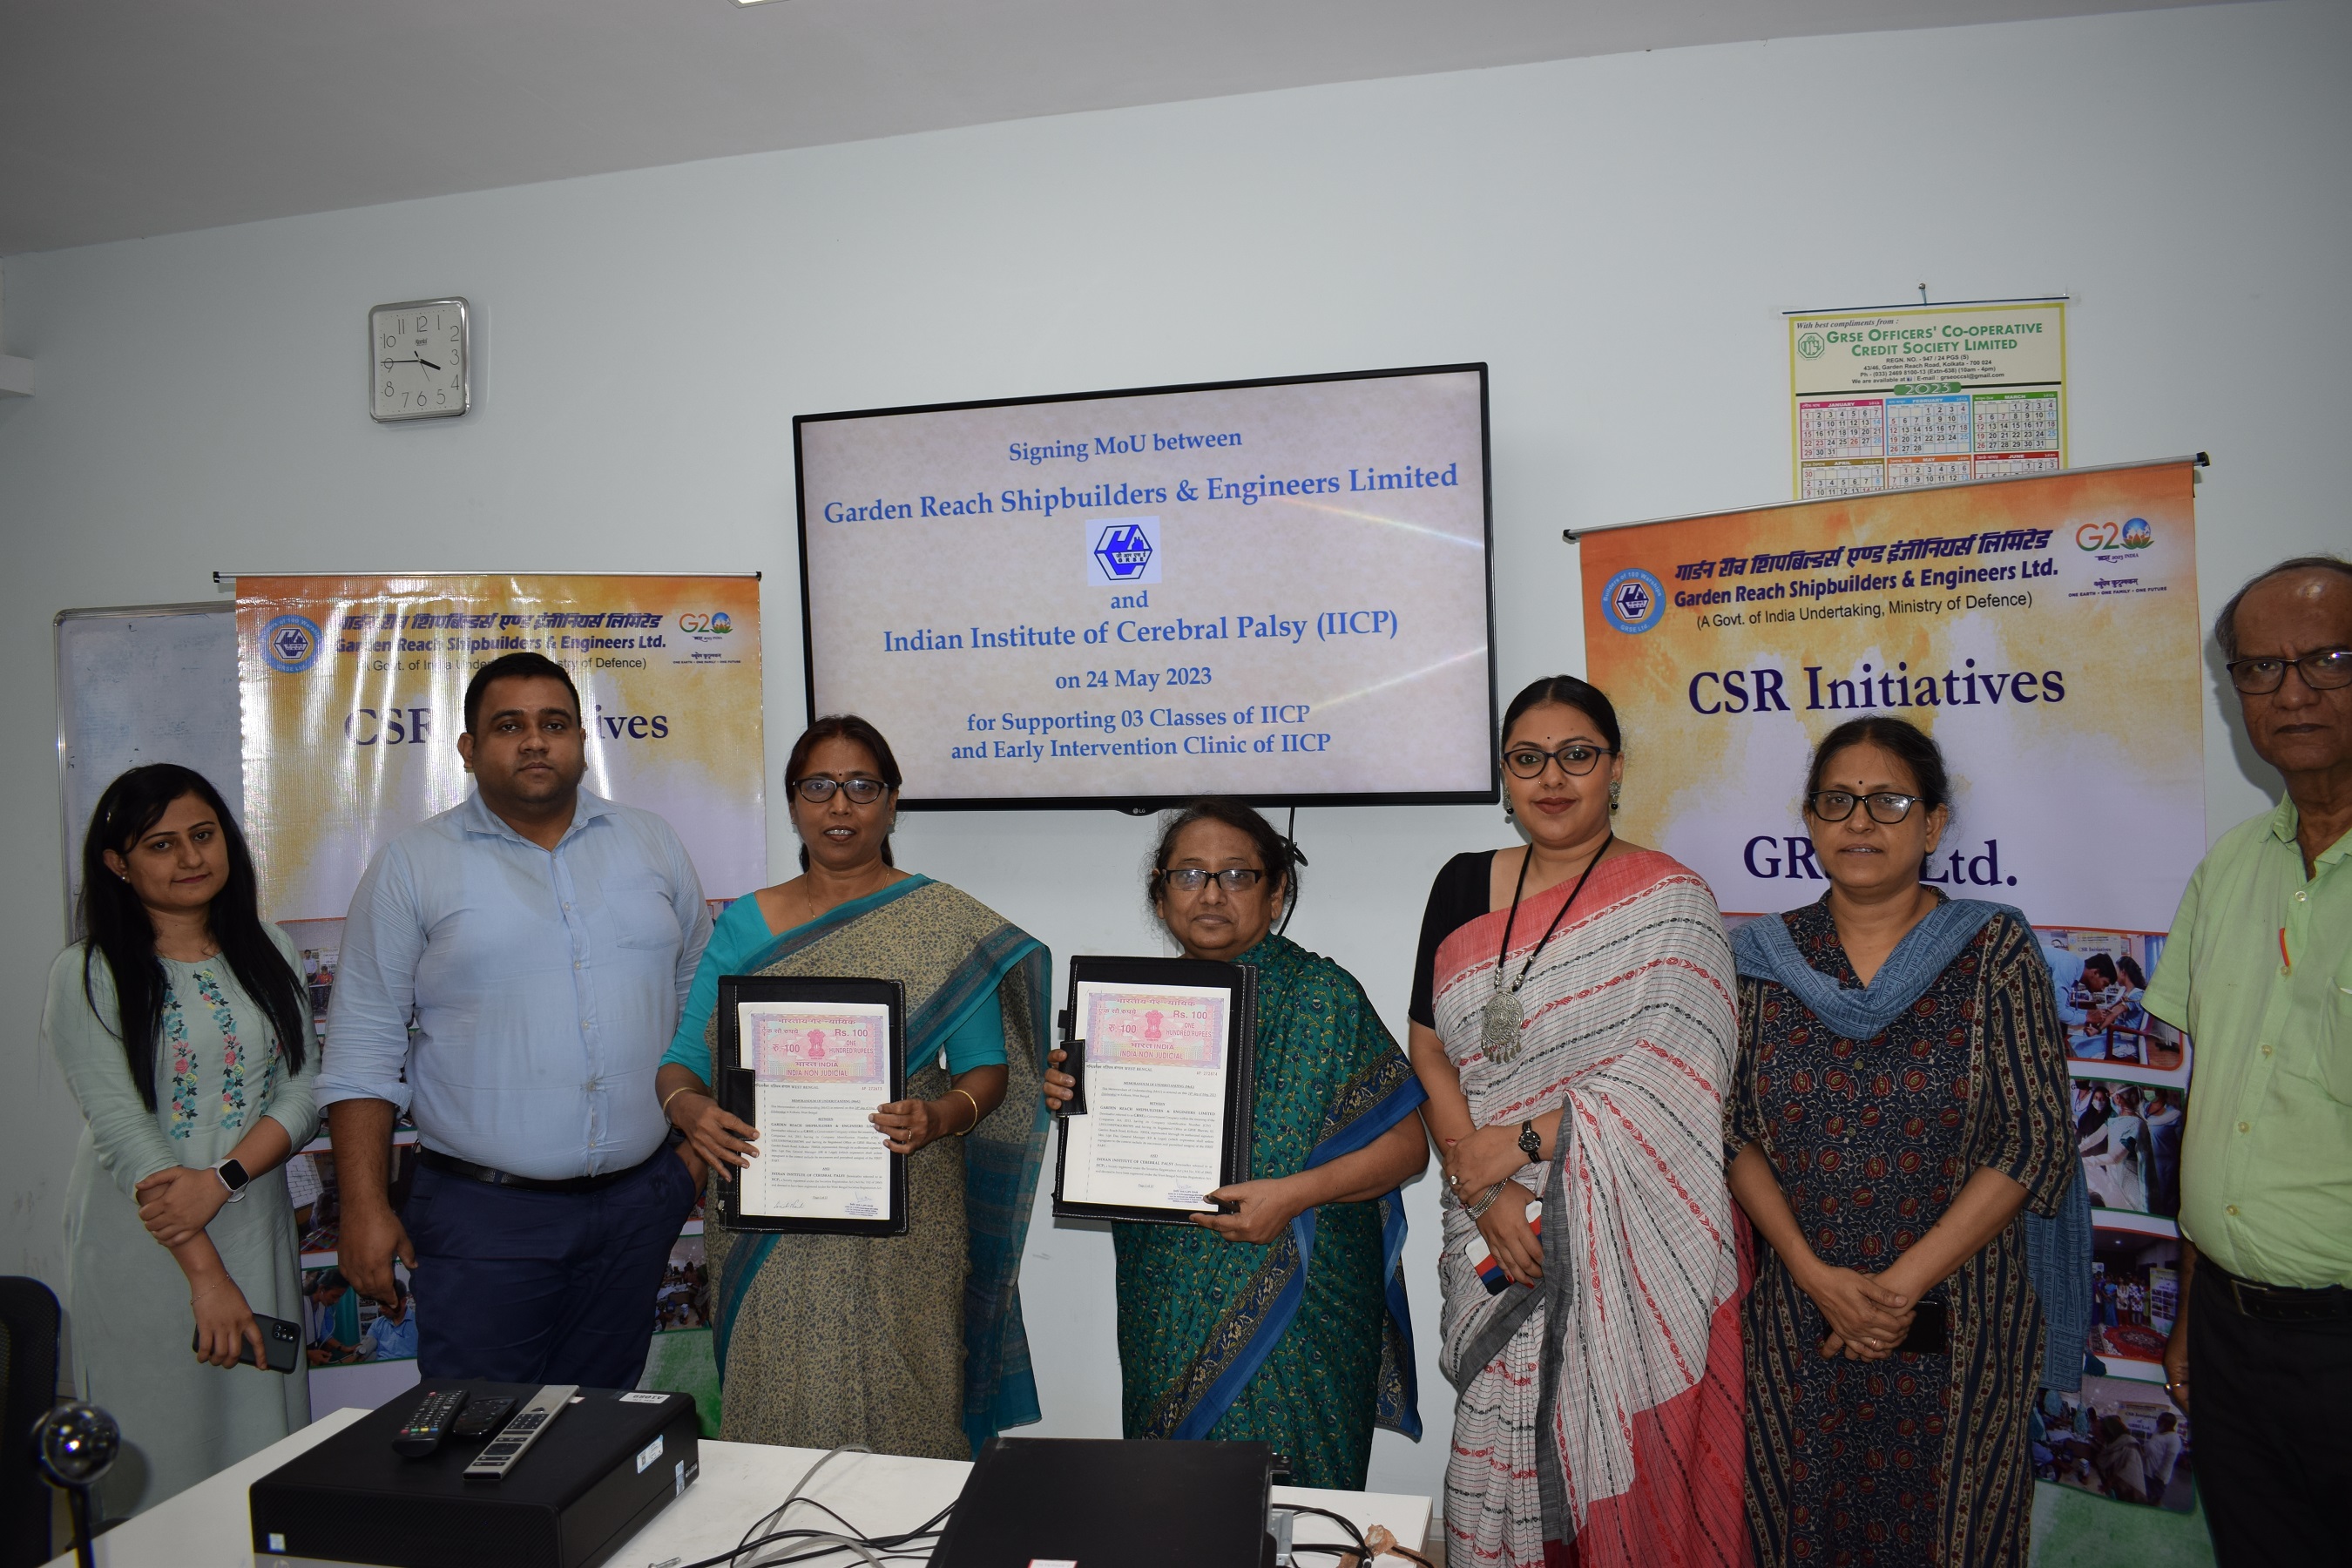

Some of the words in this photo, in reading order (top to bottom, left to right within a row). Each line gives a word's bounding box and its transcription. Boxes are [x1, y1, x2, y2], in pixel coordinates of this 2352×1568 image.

[397, 318, 405, 335] 11
[416, 315, 428, 333] 12
[437, 314, 440, 330] 1
[1830, 320, 1875, 328] compliments
[383, 334, 396, 348] 10
[450, 325, 459, 341] 2
[383, 357, 394, 373] 9
[449, 349, 459, 365] 3
[384, 381, 395, 397] 8
[450, 375, 459, 390] 4
[1905, 382, 1952, 395] 2023
[402, 392, 409, 408] 7
[416, 391, 427, 406] 6
[436, 389, 446, 405] 5
[1010, 440, 1089, 465] Signing
[1094, 435, 1146, 455] MoU
[1153, 432, 1242, 451] between
[824, 499, 913, 523] Garden
[920, 492, 993, 517] Reach
[1001, 483, 1167, 517] Shipbuilders
[1176, 479, 1199, 502] &
[1206, 474, 1341, 505] Engineers
[1348, 463, 1458, 492] Limited
[2076, 517, 2154, 551] G20
[1674, 559, 1716, 581] गार्डन
[1847, 544, 1887, 568] एण्ड
[1977, 528, 2053, 554] लिमिटेड
[1674, 589, 1731, 607] Garden
[1736, 582, 1785, 602] Reach
[1789, 574, 1897, 600] Shipbuilders
[1902, 571, 1915, 588] &
[1921, 565, 2016, 590] Engineers
[2022, 558, 2058, 578] Ltd.
[1111, 590, 1149, 609] and
[1697, 614, 1710, 631] (A
[1713, 614, 1745, 627] Govt.
[1749, 612, 1761, 625] of
[1765, 608, 1795, 623] India
[1800, 604, 1885, 620] Undertaking,
[1889, 598, 1943, 614] Ministry
[1947, 596, 1961, 611] of
[1966, 591, 2032, 609] Defence)
[679, 612, 733, 633] G20
[883, 629, 963, 652] Indian
[970, 625, 1076, 648] Institute
[1084, 621, 1109, 644] of
[1117, 616, 1228, 643] Cerebral
[1237, 614, 1308, 644] Palsy
[1317, 610, 1398, 642] (IICP)
[561, 636, 634, 652] Engineers
[639, 635, 666, 649] Ltd.
[409, 660, 421, 671] of
[596, 658, 646, 670] Defence)
[1055, 675, 1081, 689] on
[1086, 671, 1108, 688] 24
[1114, 669, 1160, 692] May
[1166, 666, 1212, 686] 2023
[1688, 667, 1791, 715] CSR
[1803, 658, 2065, 711] Initiatives
[967, 713, 997, 731] for
[1002, 710, 1116, 735] Supporting
[1121, 709, 1144, 727] 03
[1150, 708, 1227, 727] Classes
[1233, 706, 1254, 725] of
[1260, 705, 1310, 724] IICP
[951, 741, 988, 760] and
[993, 740, 1044, 763] Early
[1050, 736, 1178, 758] Intervention
[1183, 734, 1247, 754] Clinic
[1253, 734, 1275, 753] of
[1281, 733, 1331, 752] IICP
[1121, 1024, 1137, 1033] 100
